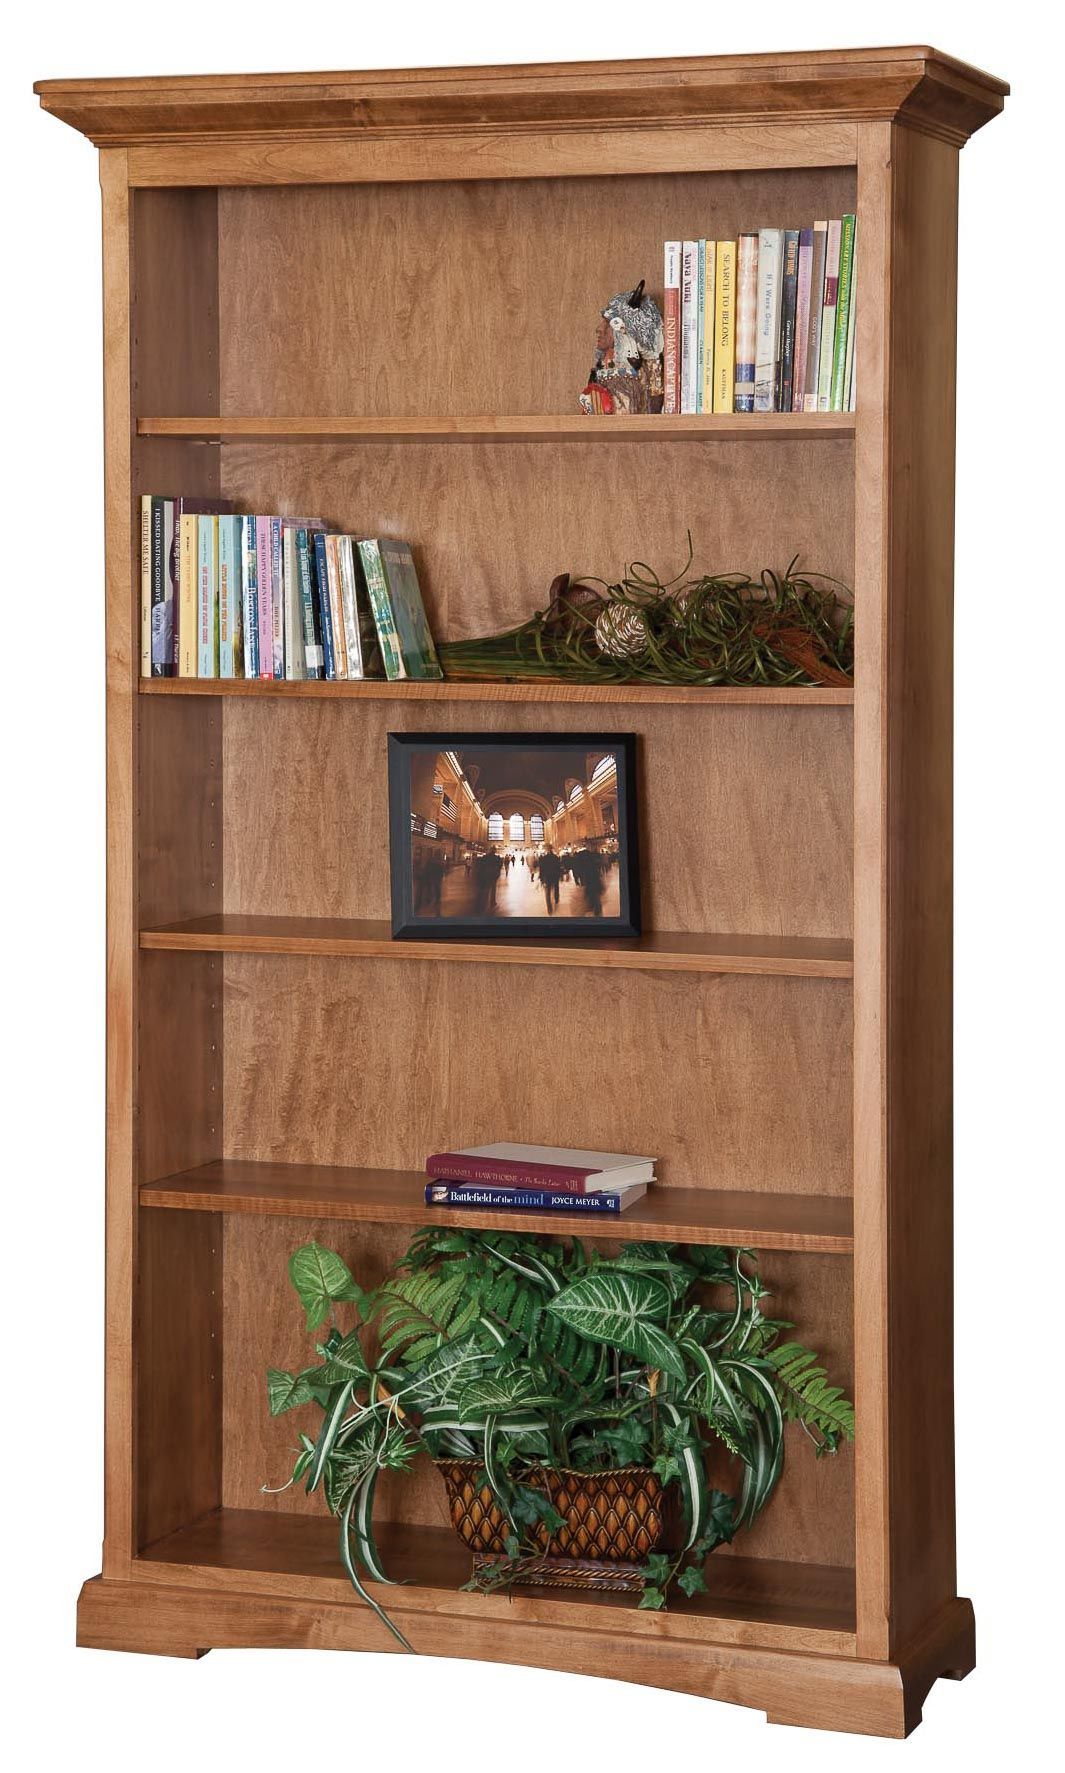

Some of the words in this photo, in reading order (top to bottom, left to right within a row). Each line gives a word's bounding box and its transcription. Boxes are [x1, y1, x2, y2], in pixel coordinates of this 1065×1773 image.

[722, 253, 731, 291] SEARCH
[722, 296, 731, 307] TO
[721, 310, 730, 347] BELONG
[763, 312, 772, 336] Going
[666, 317, 677, 357] INDIAN
[665, 359, 676, 408] CAPTIVE
[142, 510, 150, 543] SHELTER
[142, 544, 150, 555] ME
[142, 557, 150, 575] SAFE
[474, 1170, 519, 1183] HAWTHORNE
[450, 1191, 492, 1202] Battlefield
[492, 1195, 502, 1203] of
[501, 1195, 513, 1203] the
[513, 1193, 544, 1205] mind
[551, 1196, 574, 1205] JOYCE
[575, 1198, 600, 1206] MEYER
